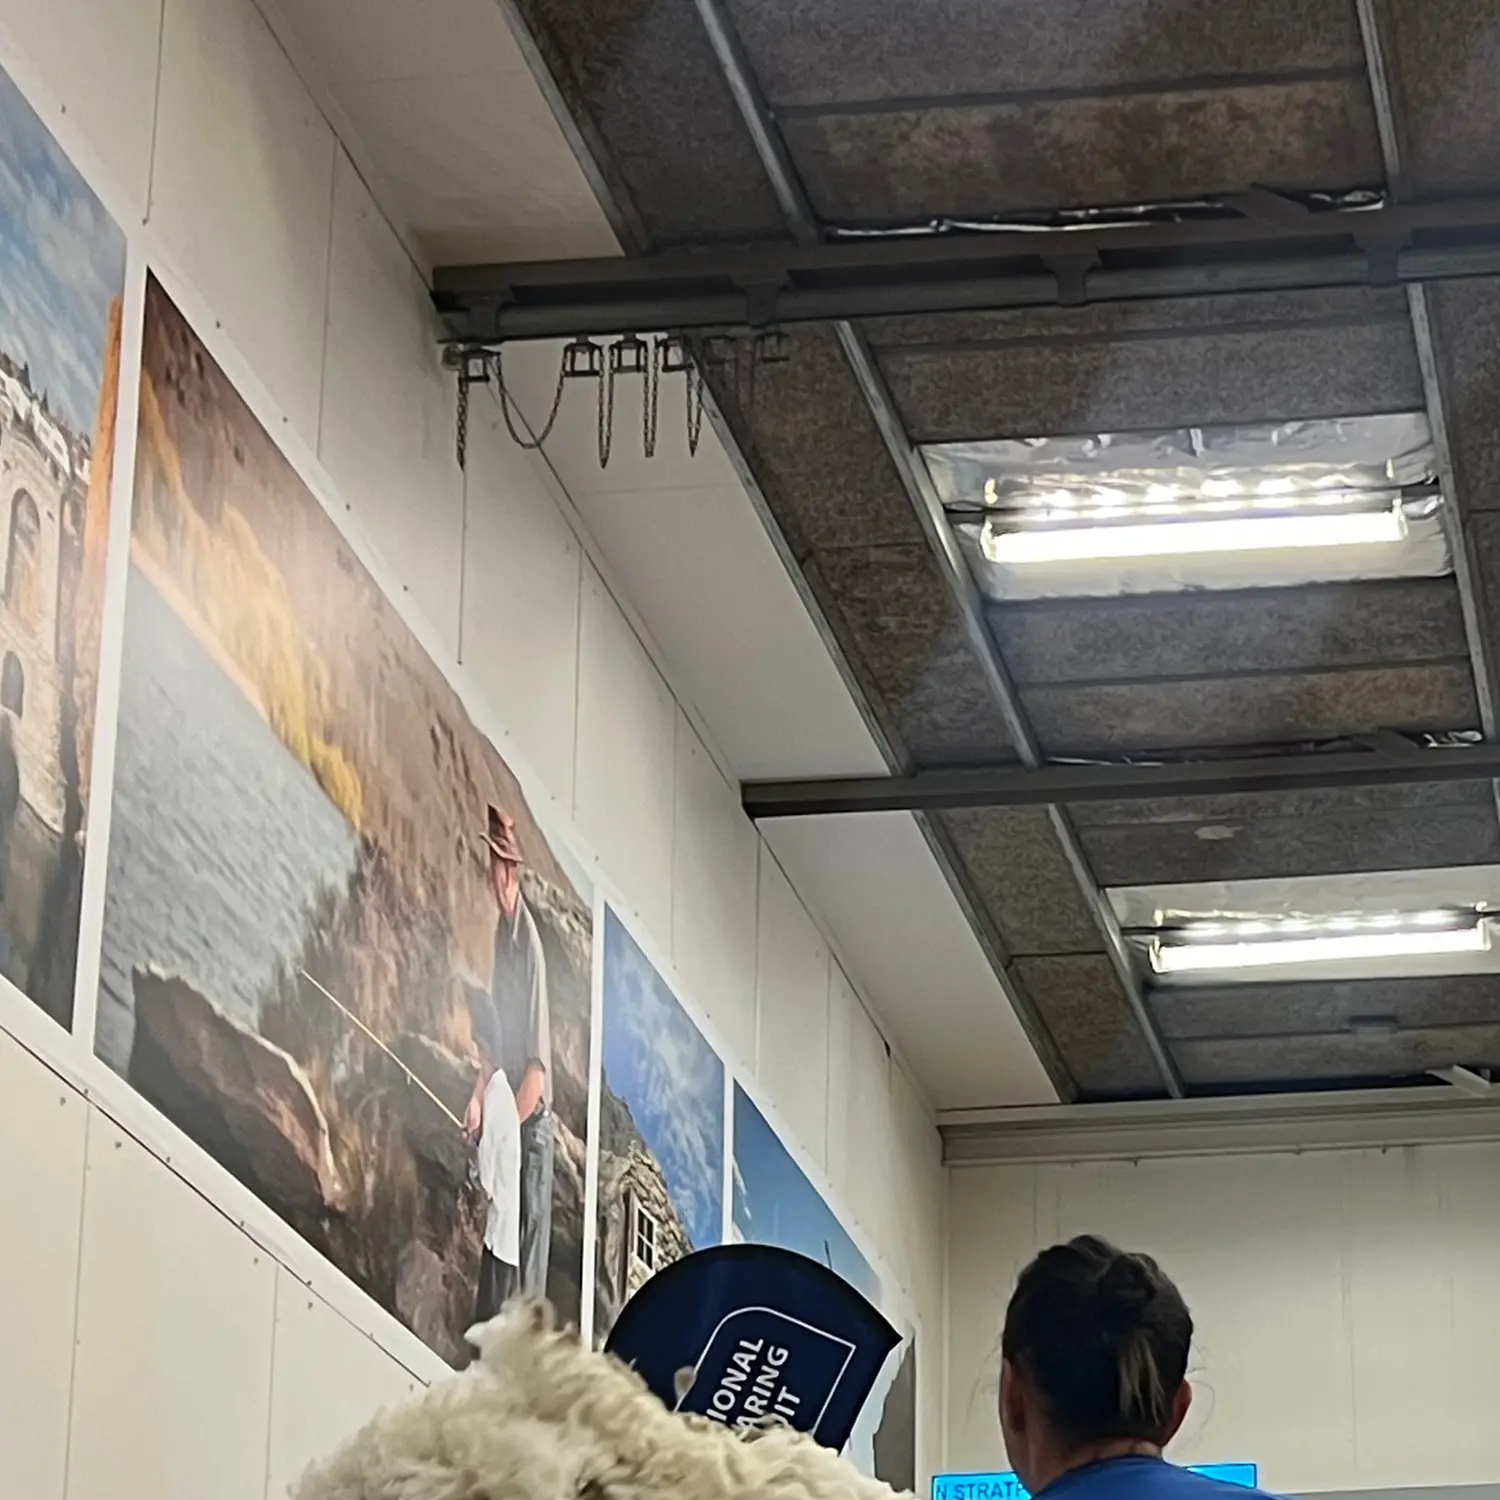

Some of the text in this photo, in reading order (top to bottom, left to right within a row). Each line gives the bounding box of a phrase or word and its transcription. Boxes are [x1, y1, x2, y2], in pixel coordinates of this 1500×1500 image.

[706, 1338, 764, 1421] IONAL
[731, 1345, 789, 1441] ARING
[936, 1484, 947, 1500] N
